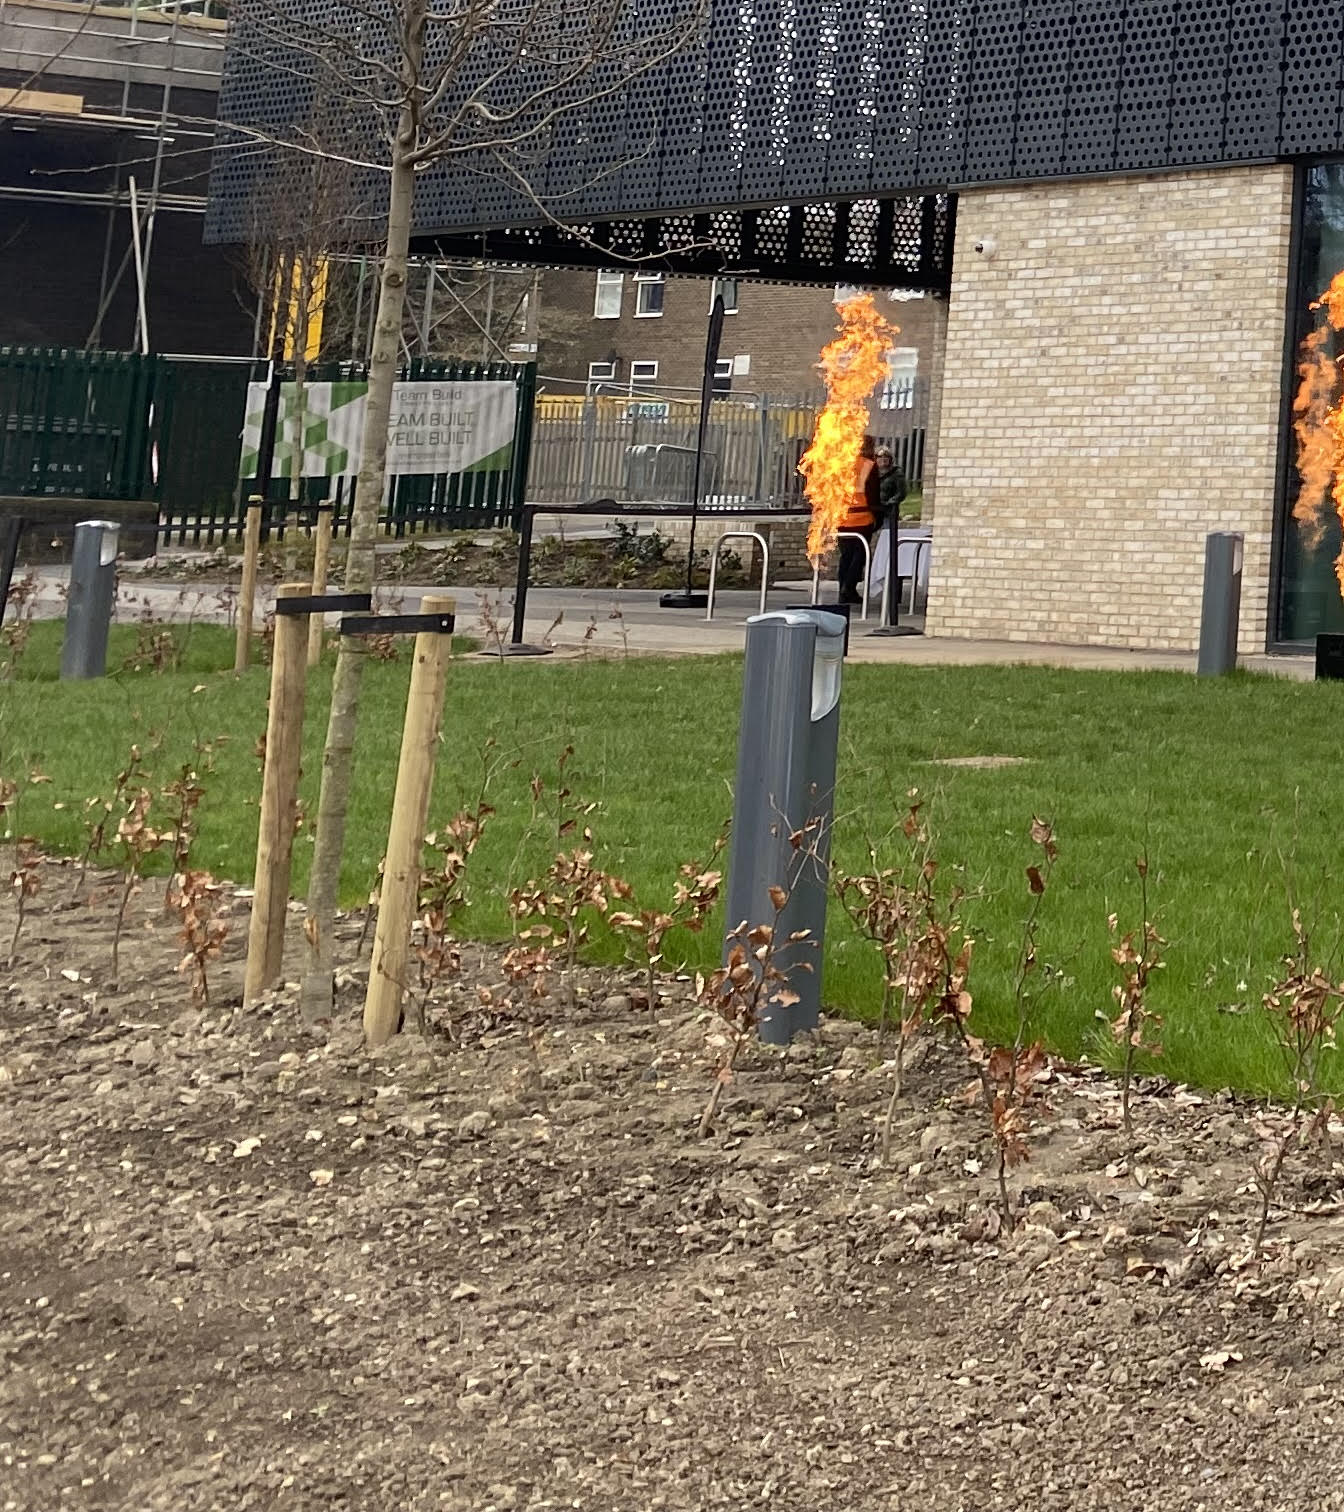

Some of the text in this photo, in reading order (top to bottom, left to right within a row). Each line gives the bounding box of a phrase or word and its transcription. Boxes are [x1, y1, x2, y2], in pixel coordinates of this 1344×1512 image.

[392, 388, 462, 402] Team Build
[388, 413, 426, 428] EAM
[429, 430, 472, 446] BUILT
